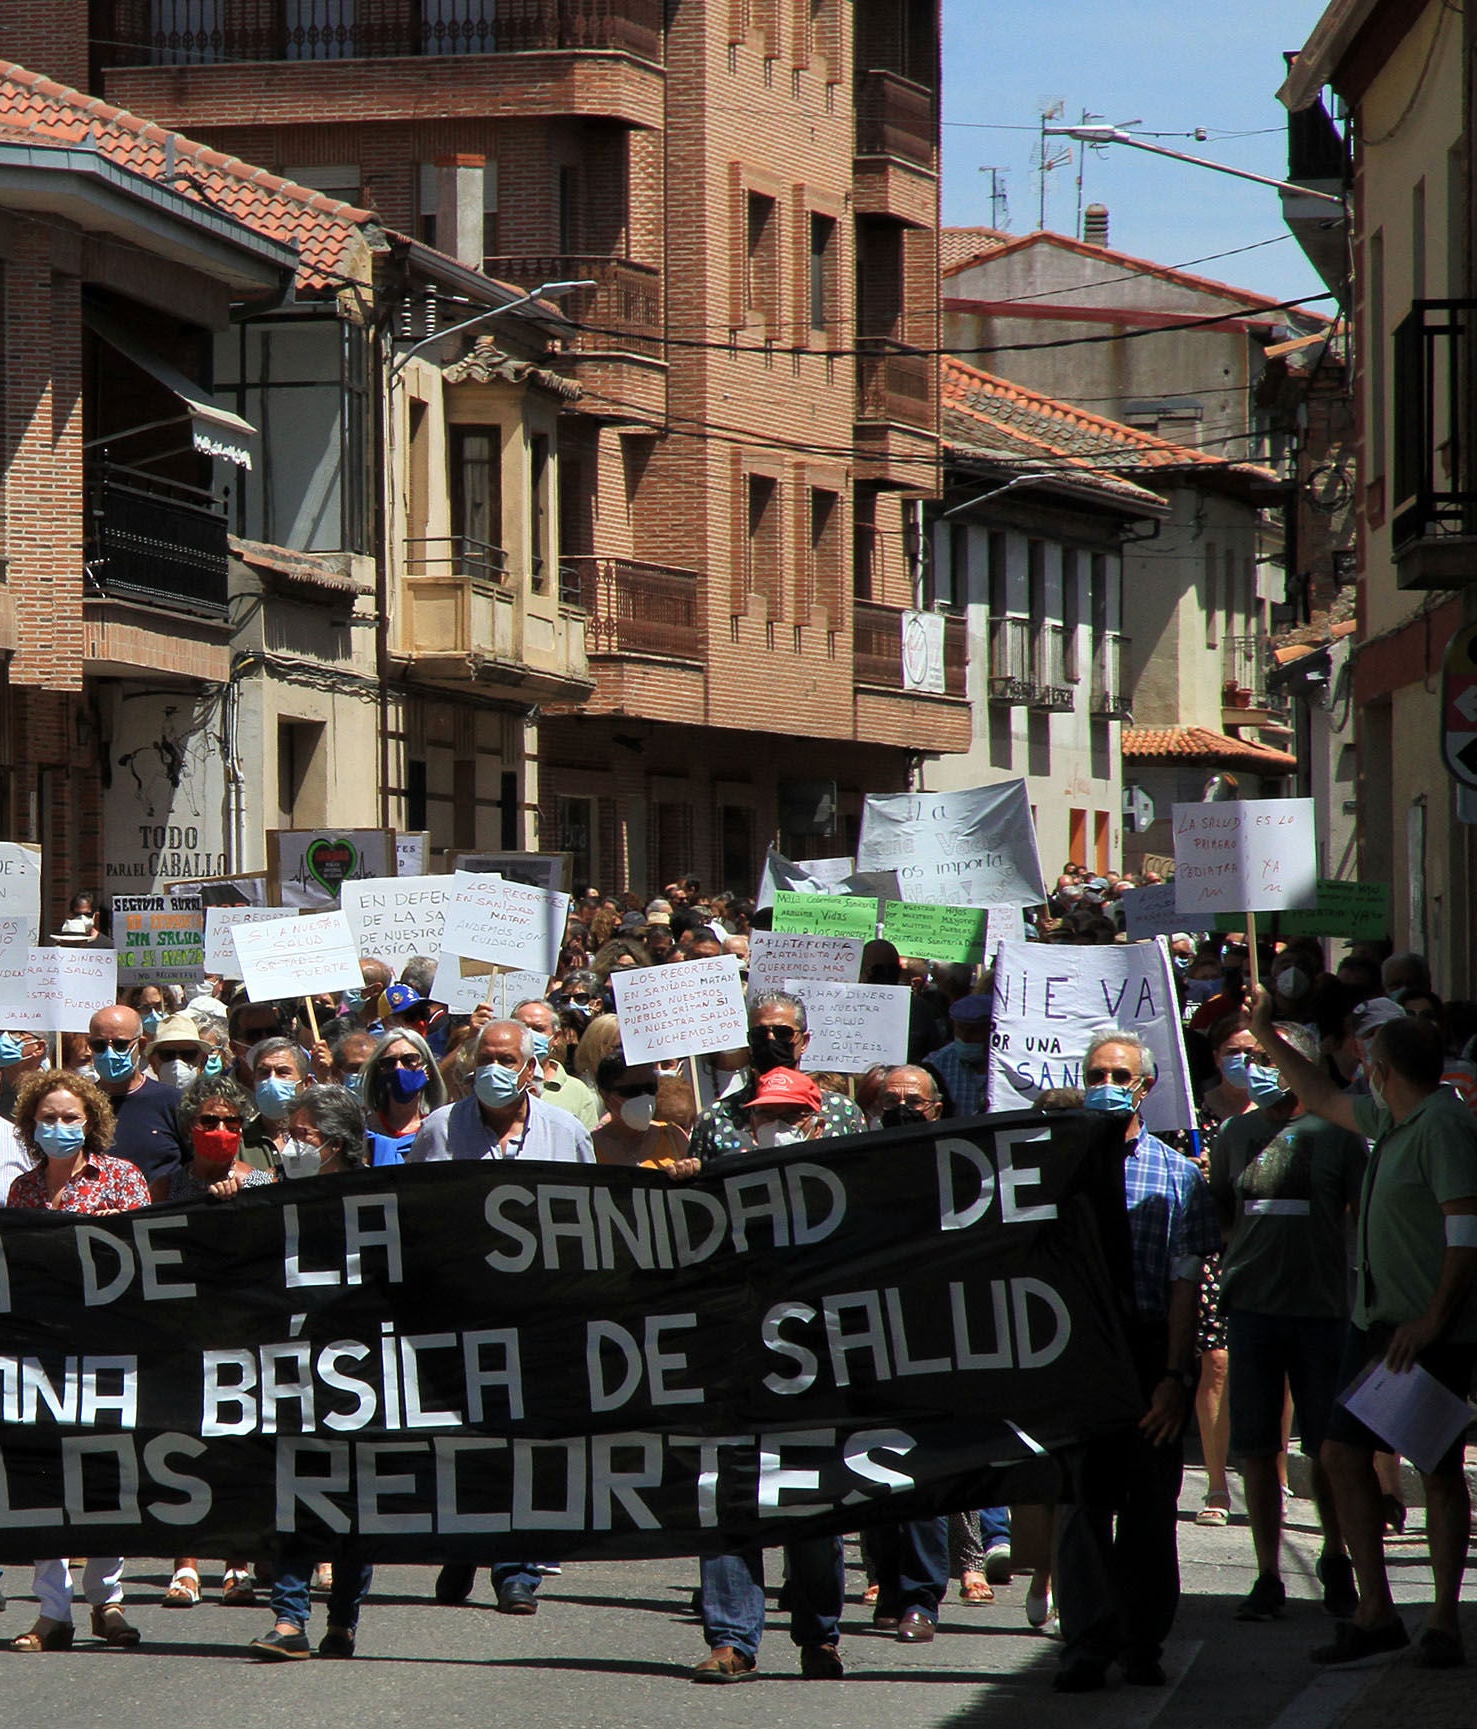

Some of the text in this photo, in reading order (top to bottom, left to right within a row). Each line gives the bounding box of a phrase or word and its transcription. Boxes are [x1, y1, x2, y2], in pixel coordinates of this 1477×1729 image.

[1178, 814, 1295, 835] LA SALUD ES LO
[138, 825, 199, 850] TODO
[1193, 838, 1237, 850] PRIMERO
[106, 863, 134, 877] PARA
[148, 852, 228, 878] CABALLO
[936, 852, 1004, 876] importa
[1175, 862, 1238, 880] PEDIATRA
[1262, 858, 1280, 879] YA
[360, 894, 386, 909] EN
[455, 892, 473, 903] EN
[467, 881, 565, 908] LOS RECORTES
[219, 914, 241, 925] DE
[363, 911, 417, 928] DE LA
[821, 910, 847, 922] Vidas
[126, 930, 202, 947] SIN SALUD
[360, 932, 377, 945] DE
[456, 919, 546, 946] ANDEMOS CON
[471, 934, 526, 950] CUIDADO
[766, 938, 853, 950] PLATAFORMA
[42, 953, 114, 965] HAY DINERO
[834, 952, 856, 962] NO
[46, 966, 104, 978] LA SALUD
[292, 961, 350, 978] FUERTE
[629, 961, 724, 986] LOS RECORTES
[757, 963, 818, 974] QUEREMOS
[38, 977, 58, 986] DE
[623, 991, 639, 1002] EN
[699, 972, 736, 986] MATAN
[816, 987, 895, 1000] HAY DINERO
[625, 1000, 663, 1013] TODOS
[829, 1002, 881, 1013] NUESTRA
[624, 1010, 669, 1026] PUEBLOS
[633, 1016, 695, 1036] A NUESTRA
[822, 1015, 866, 1027] SALUD
[647, 1020, 743, 1049] LUCHEMOS POR
[701, 1034, 731, 1048] ELLO
[819, 1030, 863, 1039] NOS LA
[1025, 1035, 1062, 1054] UNA
[75, 1215, 198, 1308] DE
[283, 1192, 402, 1288] LA
[484, 1163, 846, 1273] SANIDAD
[935, 1126, 1059, 1231] DE
[587, 1312, 705, 1413] DE
[760, 1277, 1072, 1396] SALUD
[276, 1427, 919, 1535] RECORTES
